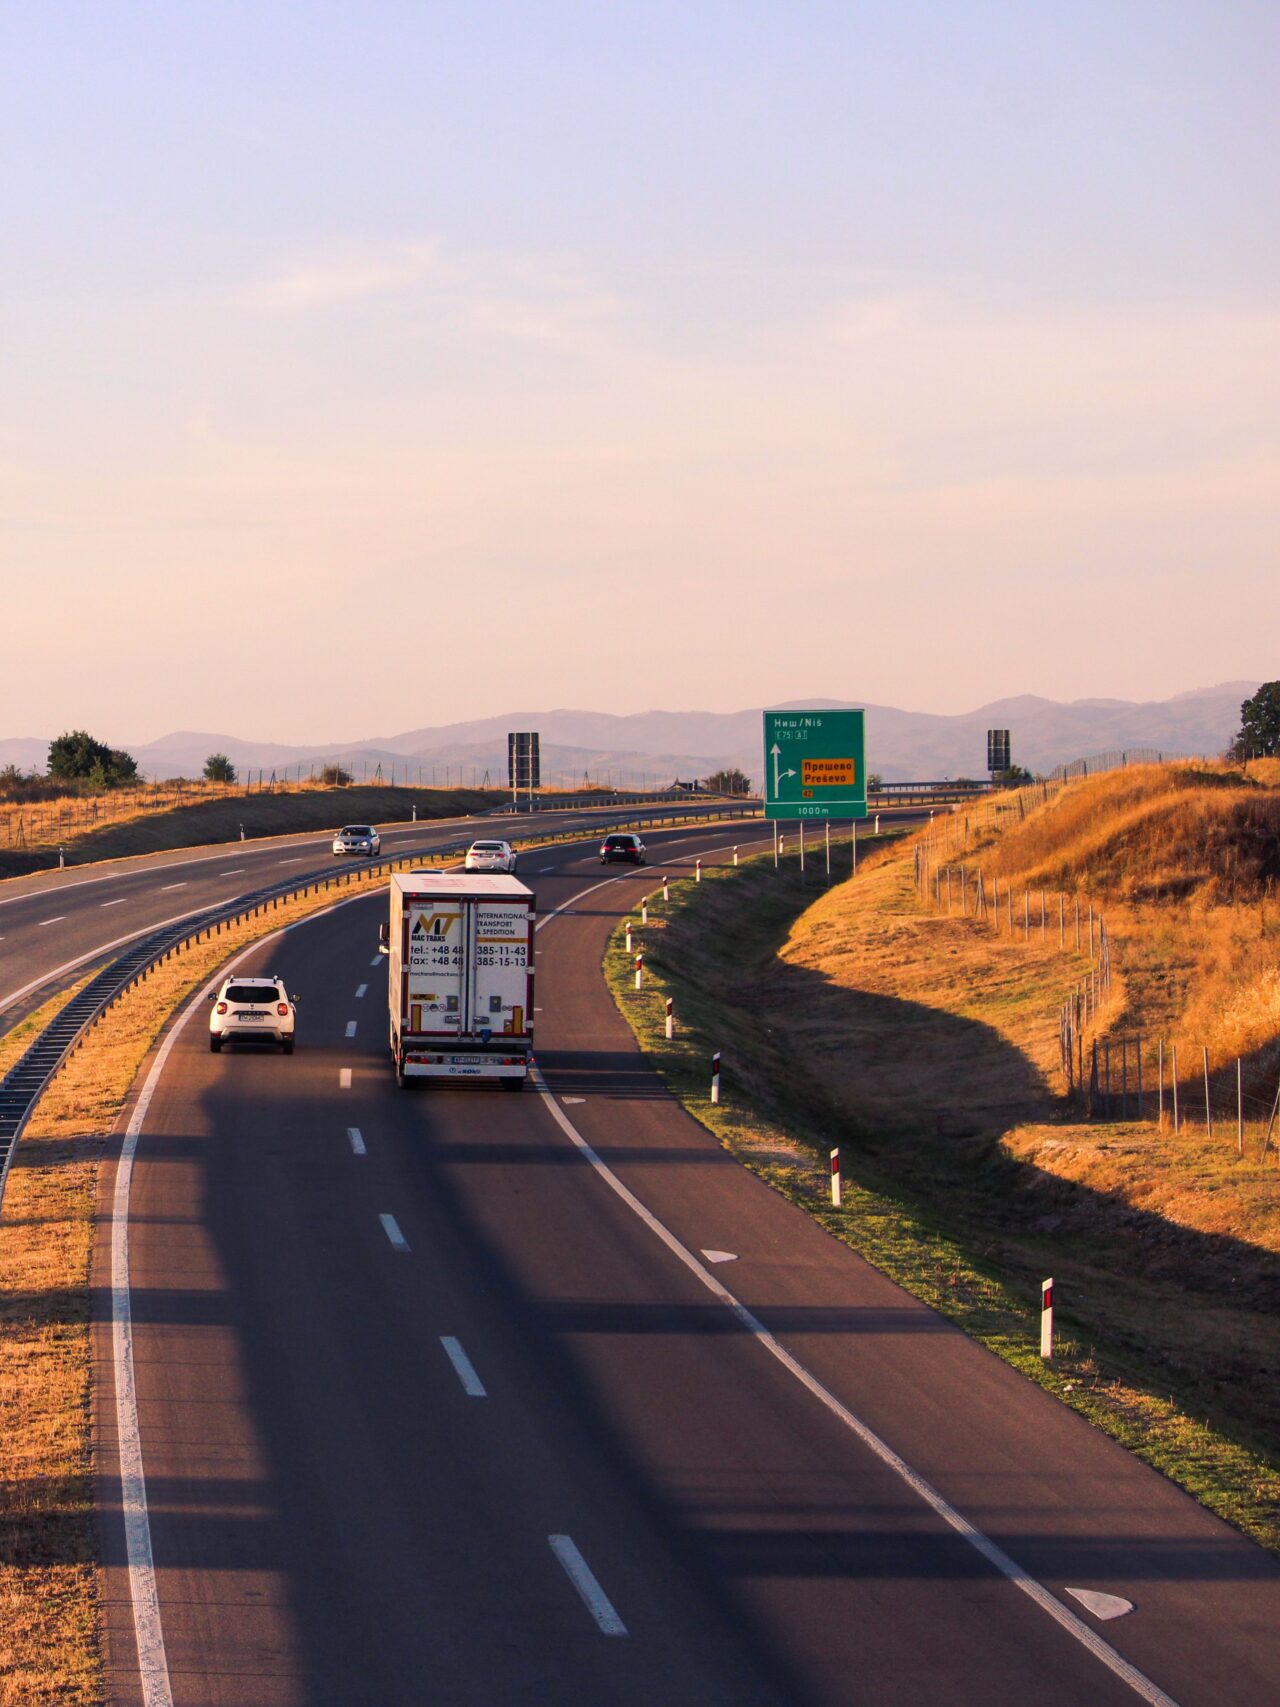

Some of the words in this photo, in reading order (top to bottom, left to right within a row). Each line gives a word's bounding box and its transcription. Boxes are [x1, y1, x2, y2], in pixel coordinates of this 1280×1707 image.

[804, 762, 852, 772] Прешево
[804, 774, 846, 783] Preševo
[476, 912, 527, 920] INTERNATIONAL
[476, 920, 513, 928] TRANSPORT
[411, 934, 426, 942] MAC
[410, 946, 429, 955] tel.:
[432, 946, 450, 955] +48
[452, 946, 464, 955] 48
[477, 946, 526, 956] 385-11-43
[410, 957, 429, 966] fax:
[432, 957, 450, 966] +48
[452, 957, 464, 966] 48
[477, 957, 526, 967] 385-15-13
